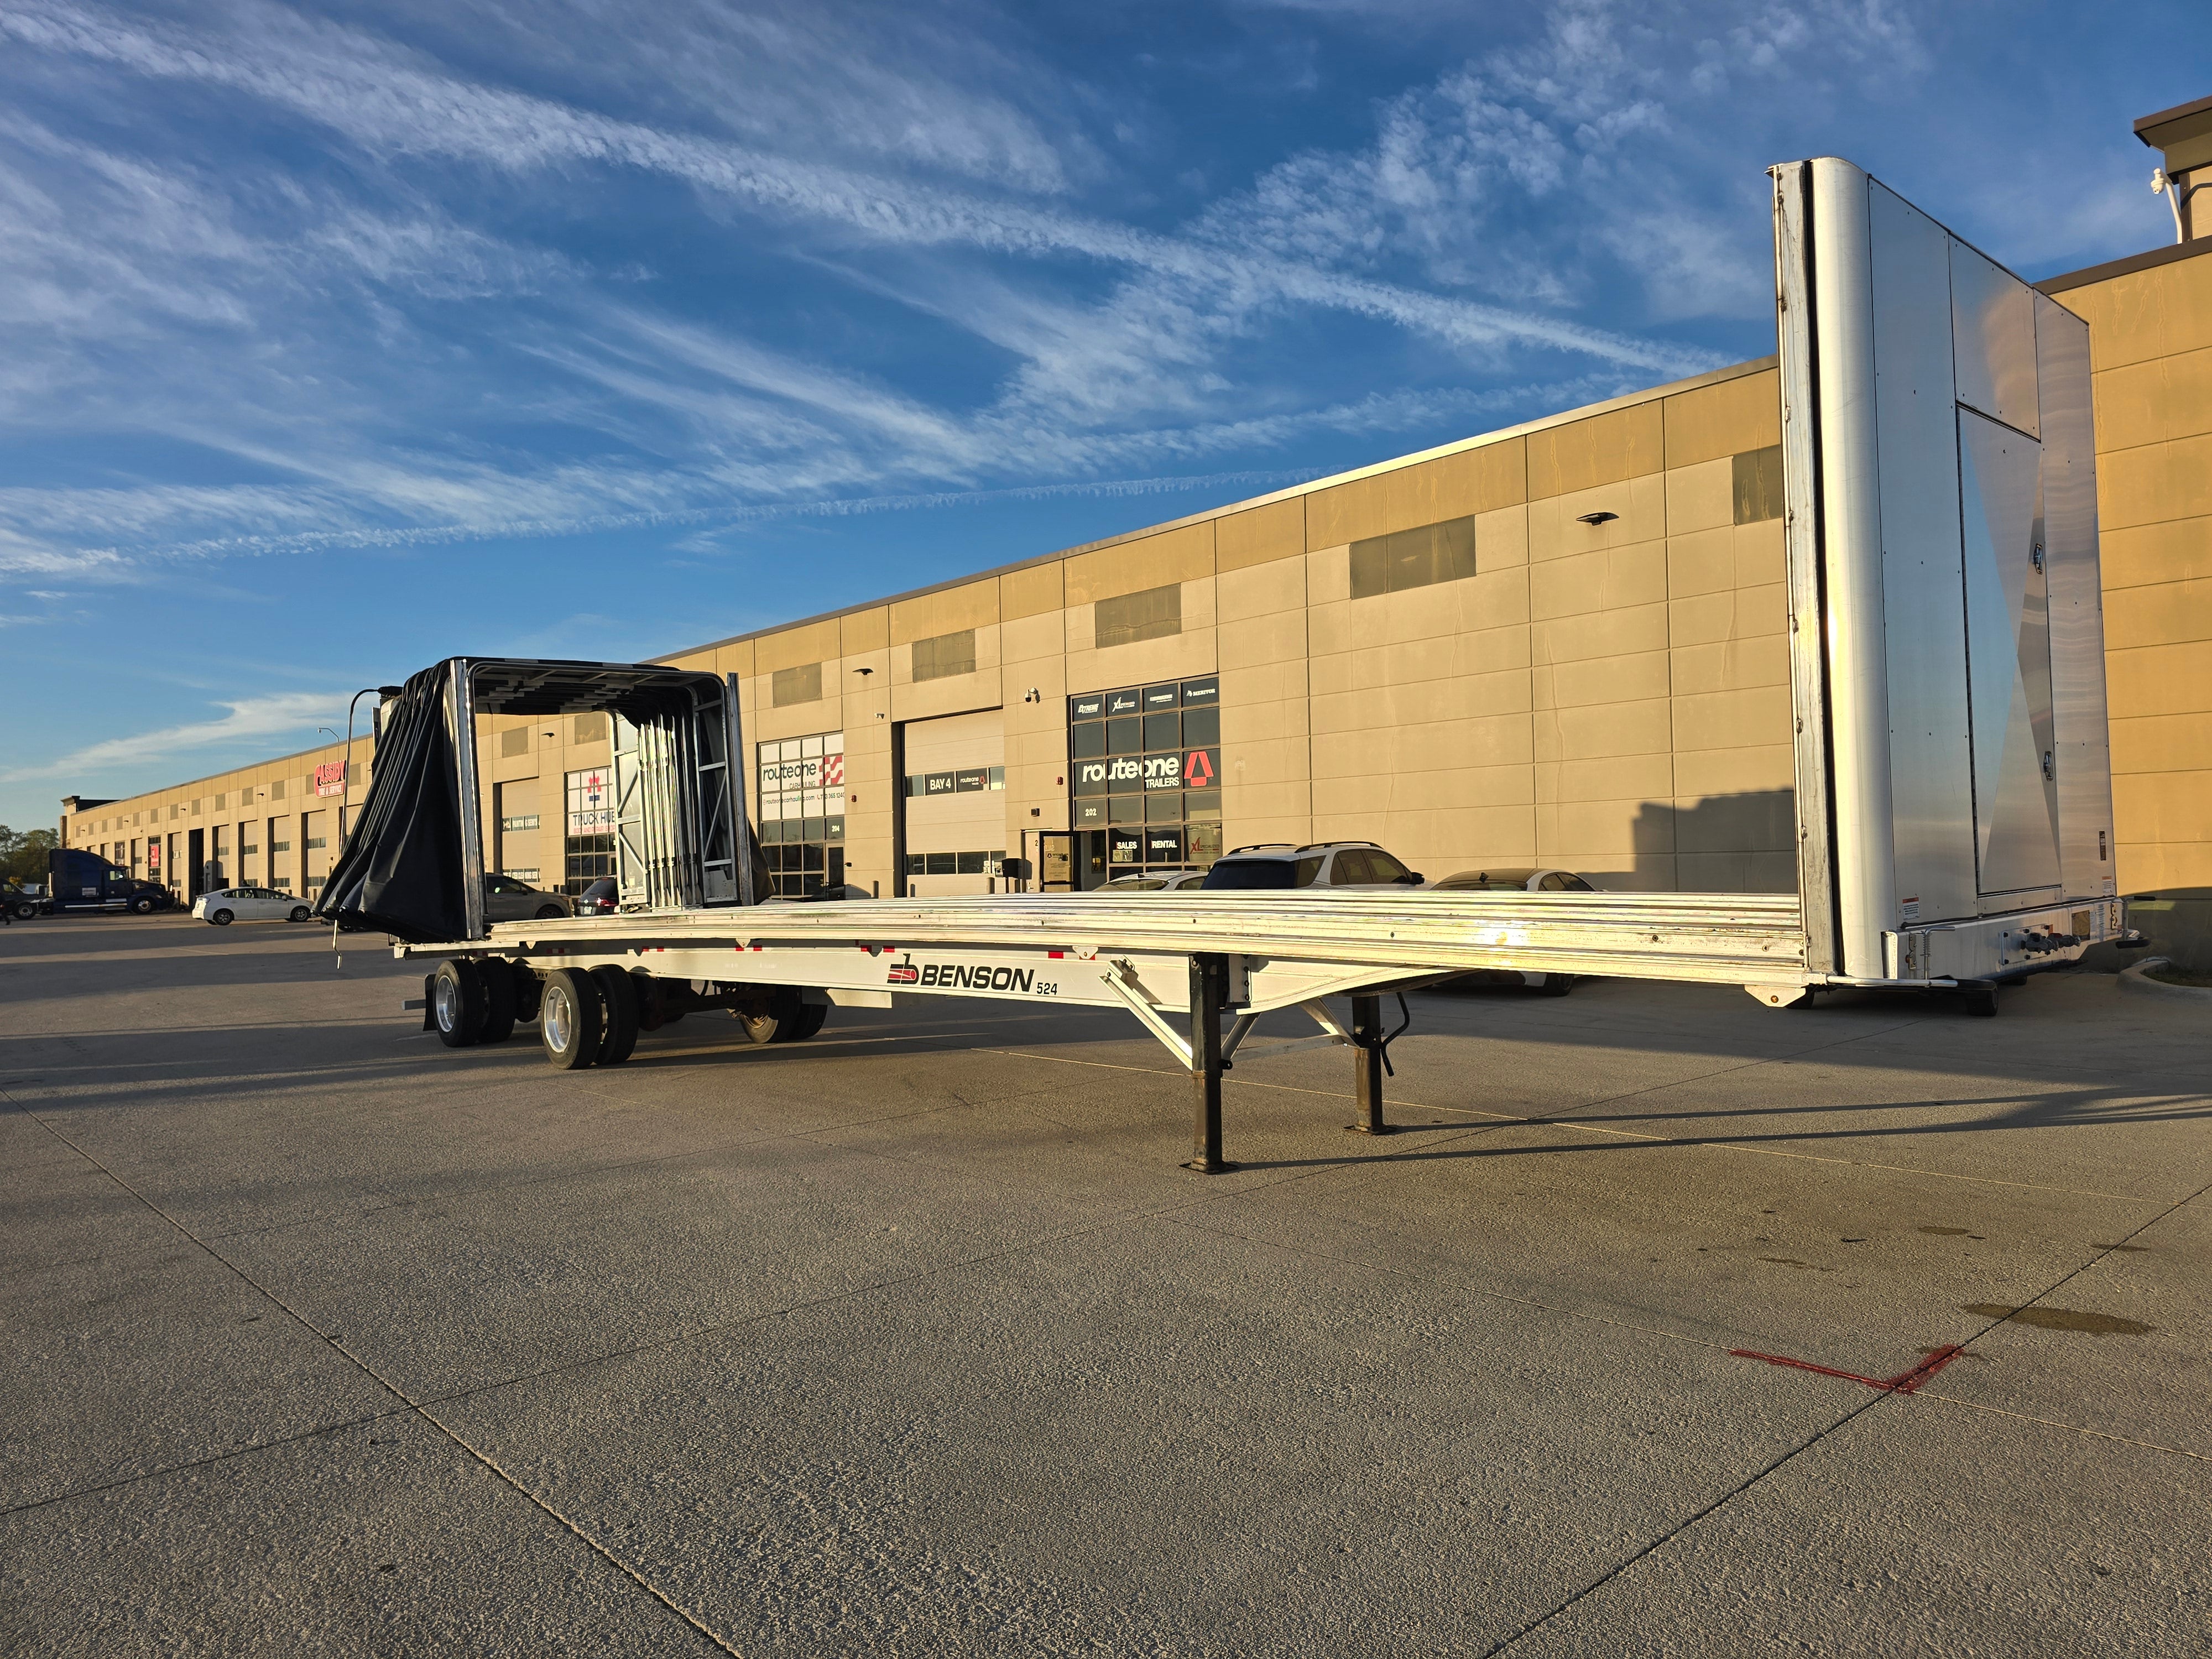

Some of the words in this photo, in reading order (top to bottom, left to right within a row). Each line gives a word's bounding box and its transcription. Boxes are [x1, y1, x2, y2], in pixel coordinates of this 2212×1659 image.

[314, 760, 346, 787] CASSIDY
[763, 763, 817, 781] routeone
[1083, 757, 1180, 782] routeone
[789, 780, 816, 789] CARHULING
[930, 779, 945, 790] BAY
[946, 778, 951, 789] 4
[1145, 777, 1180, 788] TRAILERS
[1085, 808, 1097, 817] 202
[573, 812, 599, 826] TRUCK
[1117, 841, 1138, 849] SALES
[1151, 840, 1177, 849] RENTAL
[921, 964, 1035, 992] BENSON
[1037, 982, 1057, 995] 524
